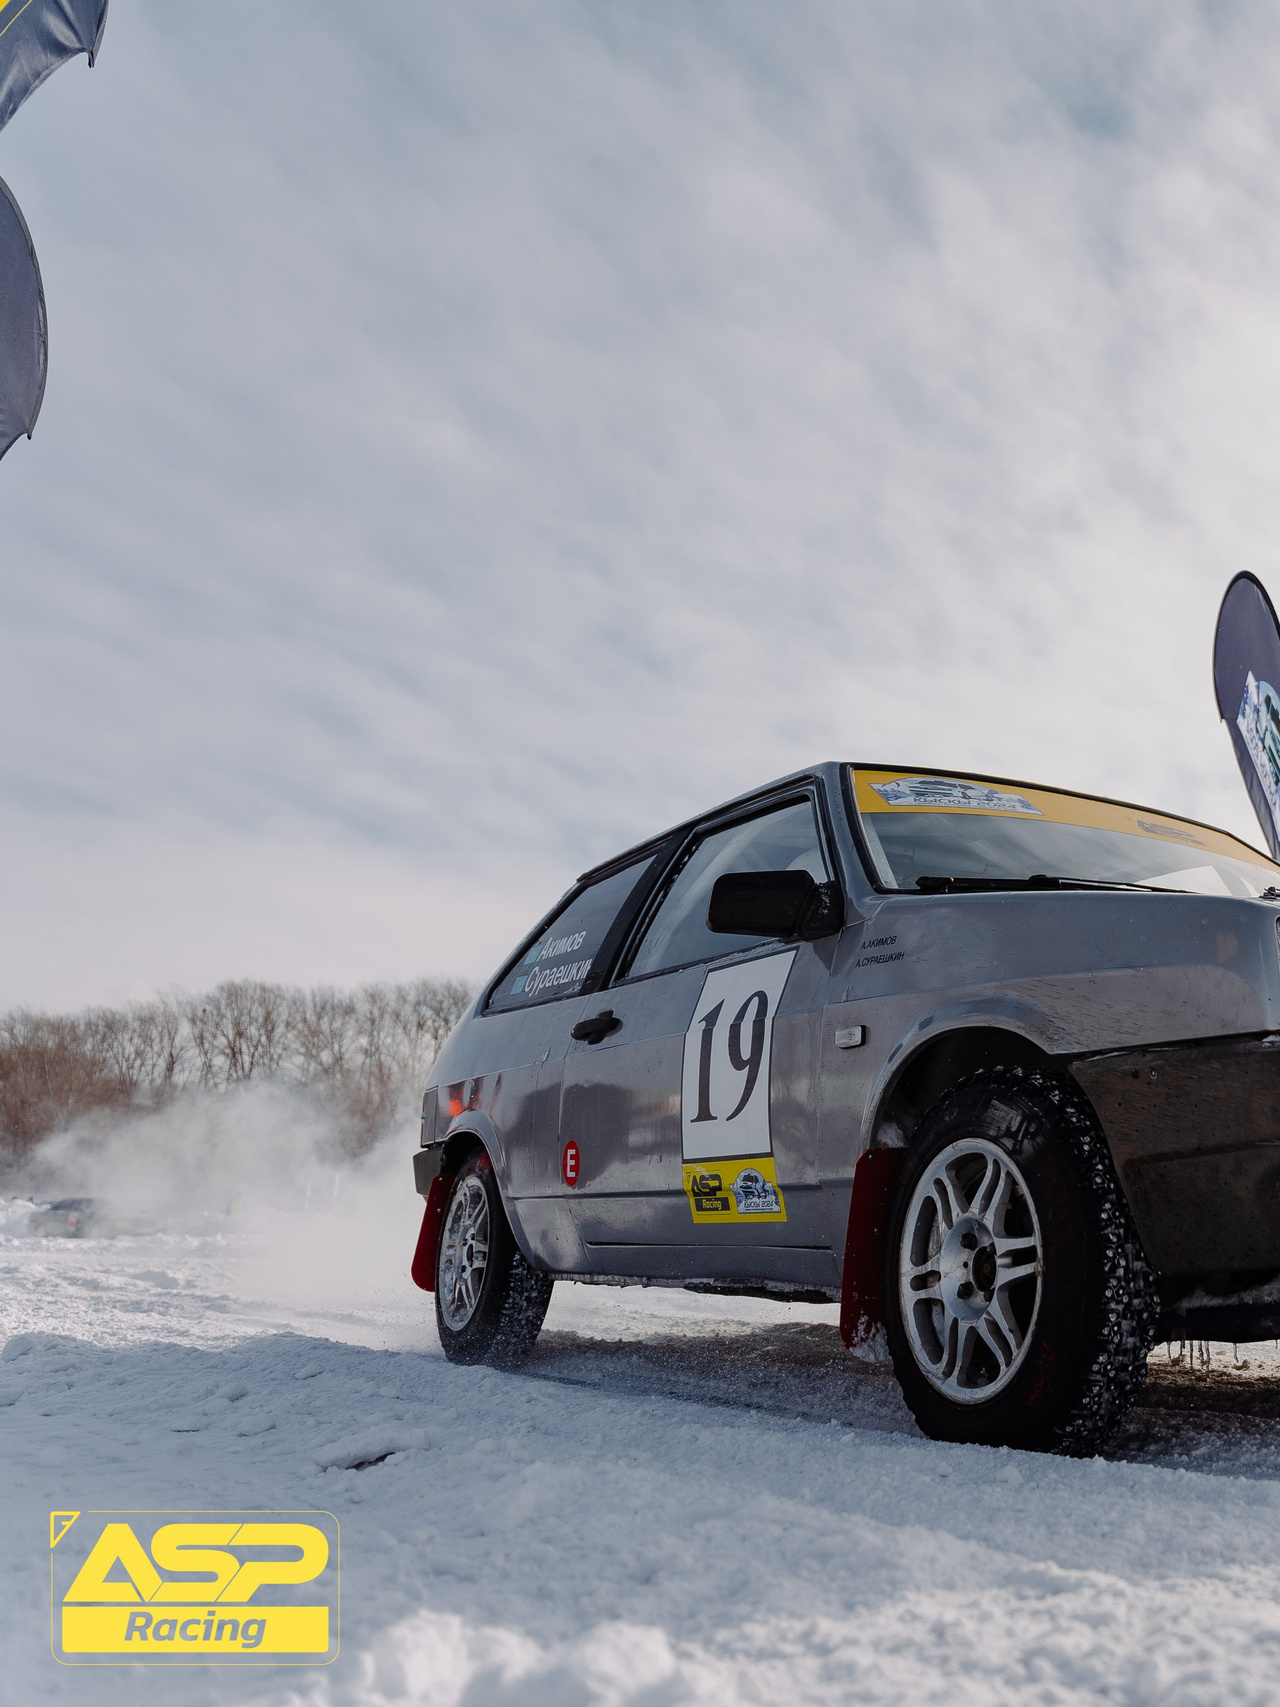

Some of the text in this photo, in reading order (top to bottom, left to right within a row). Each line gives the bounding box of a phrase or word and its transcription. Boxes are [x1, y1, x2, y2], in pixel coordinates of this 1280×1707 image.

[537, 931, 586, 961] Акимов
[690, 990, 768, 1123] 19
[691, 1174, 723, 1197] ASP
[702, 1199, 722, 1210] Racing
